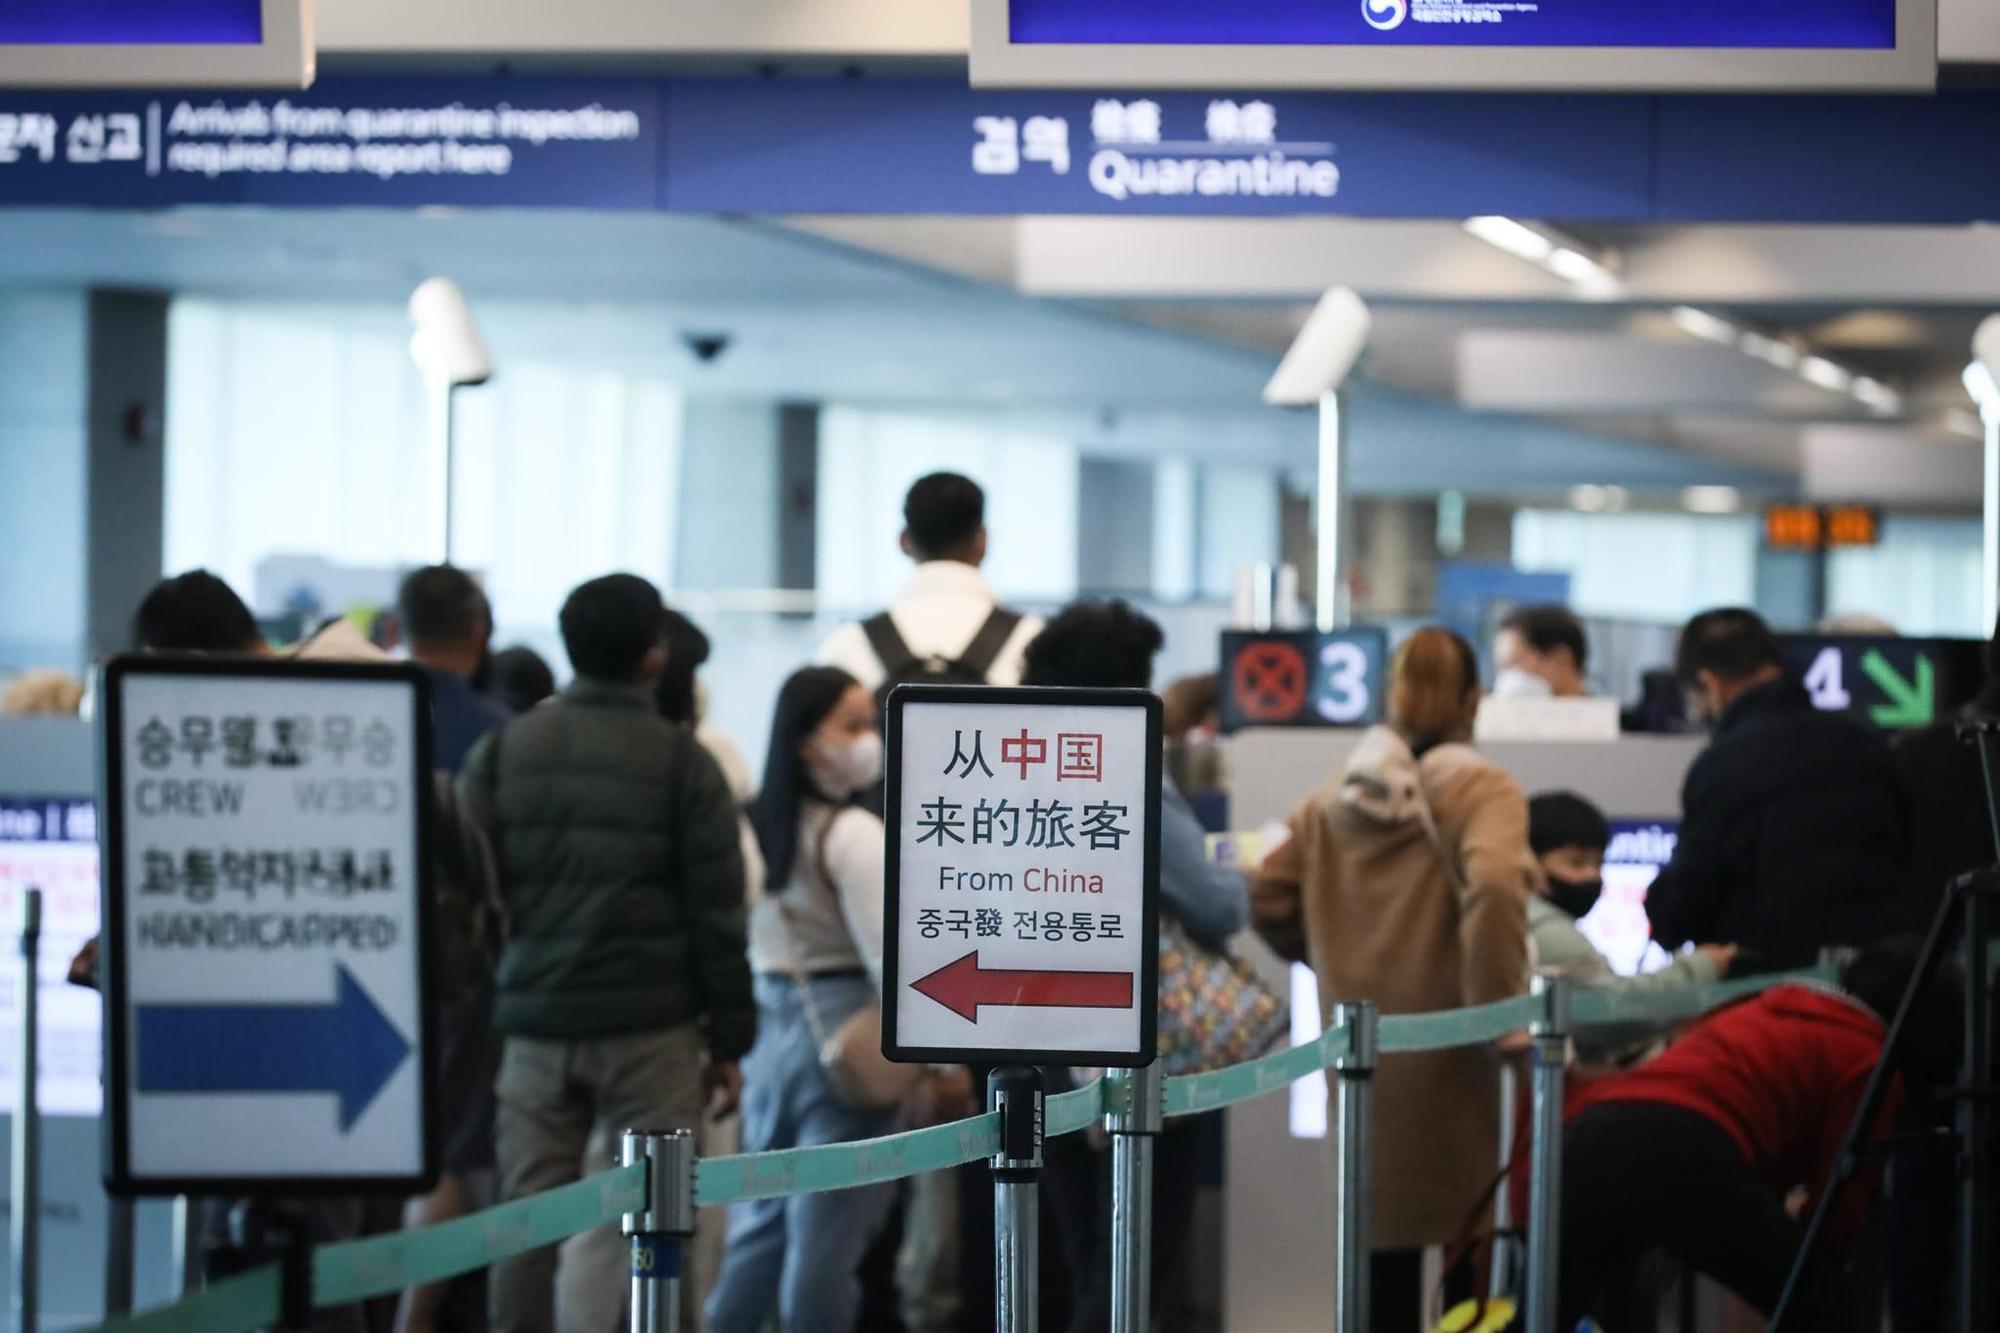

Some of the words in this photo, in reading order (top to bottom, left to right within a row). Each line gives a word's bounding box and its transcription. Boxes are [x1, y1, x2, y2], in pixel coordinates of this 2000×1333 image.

[273, 99, 343, 137] from
[344, 103, 497, 143] quarantine
[497, 102, 640, 146] inspection
[971, 116, 1070, 175] 검역
[167, 137, 288, 178] required
[289, 142, 352, 172] area
[353, 140, 443, 180] report
[443, 139, 512, 175] here
[1089, 149, 1340, 201] Quarantine
[1316, 640, 1371, 724] 3
[1803, 646, 1851, 711] 4
[943, 728, 1103, 783] 从中国
[135, 778, 246, 817] CREW
[915, 795, 1132, 851] 来的旅客
[939, 866, 1013, 892] From
[1023, 867, 1105, 895] China
[138, 911, 397, 952] HANDICAPPED
[916, 908, 1003, 940] 중국發
[1012, 911, 1125, 943] 전용통로
